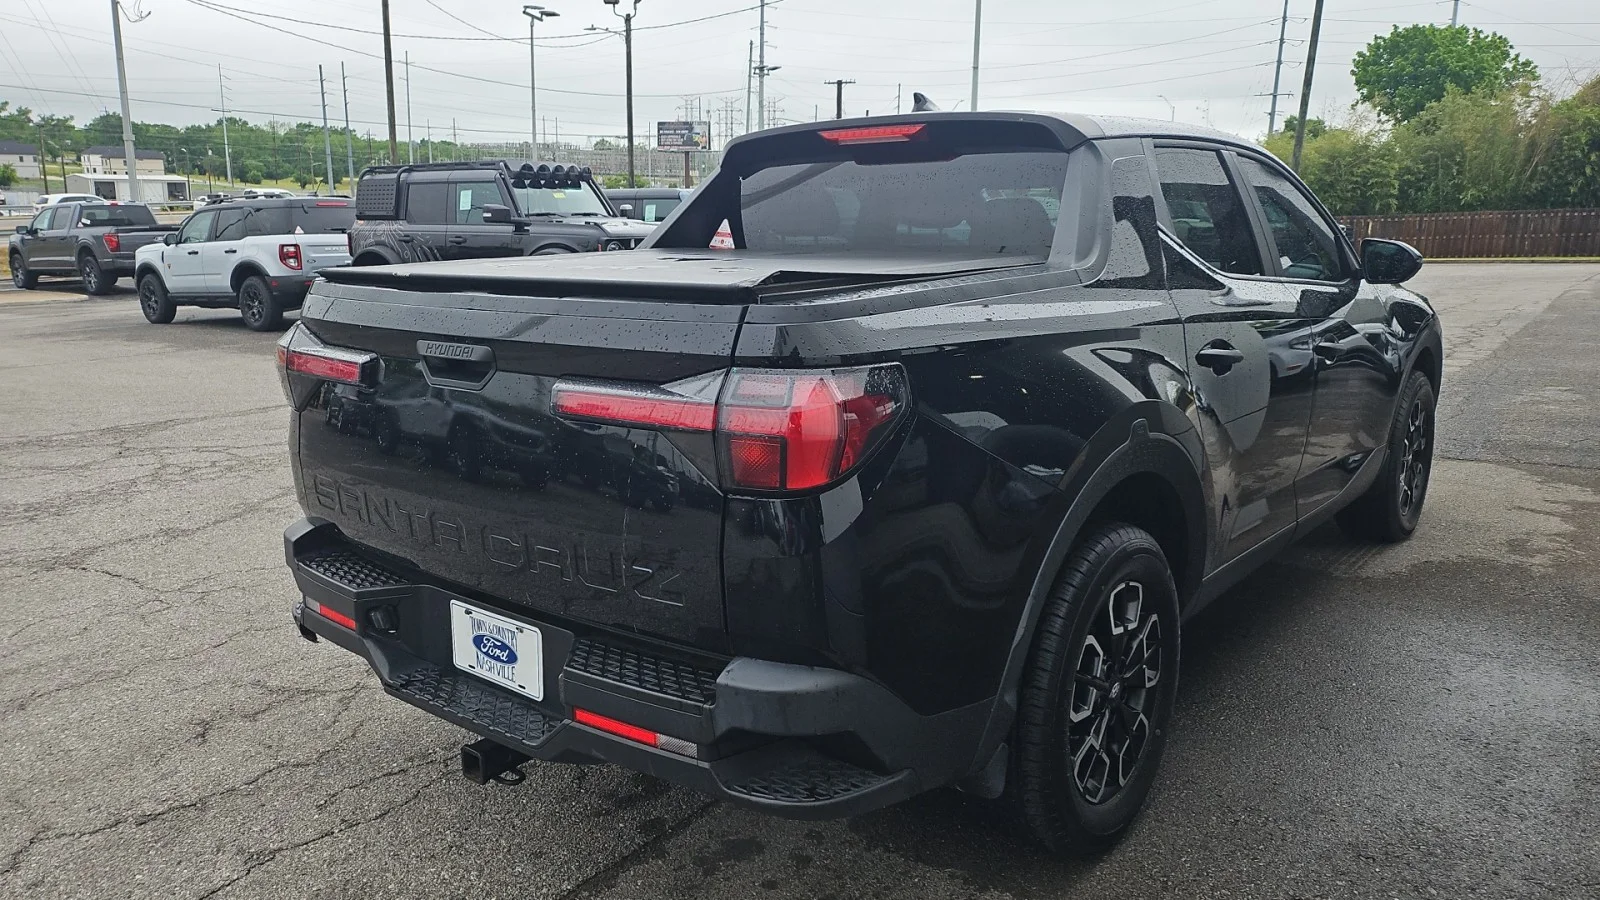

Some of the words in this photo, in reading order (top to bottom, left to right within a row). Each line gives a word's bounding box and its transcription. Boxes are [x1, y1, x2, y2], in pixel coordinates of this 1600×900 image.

[425, 343, 475, 359] HYUNDAI
[314, 473, 467, 554] SANTA
[480, 523, 684, 607] CRUZ
[469, 616, 488, 635] TOWN
[480, 636, 509, 661] Ford
[476, 650, 516, 683] NASHVILLE
